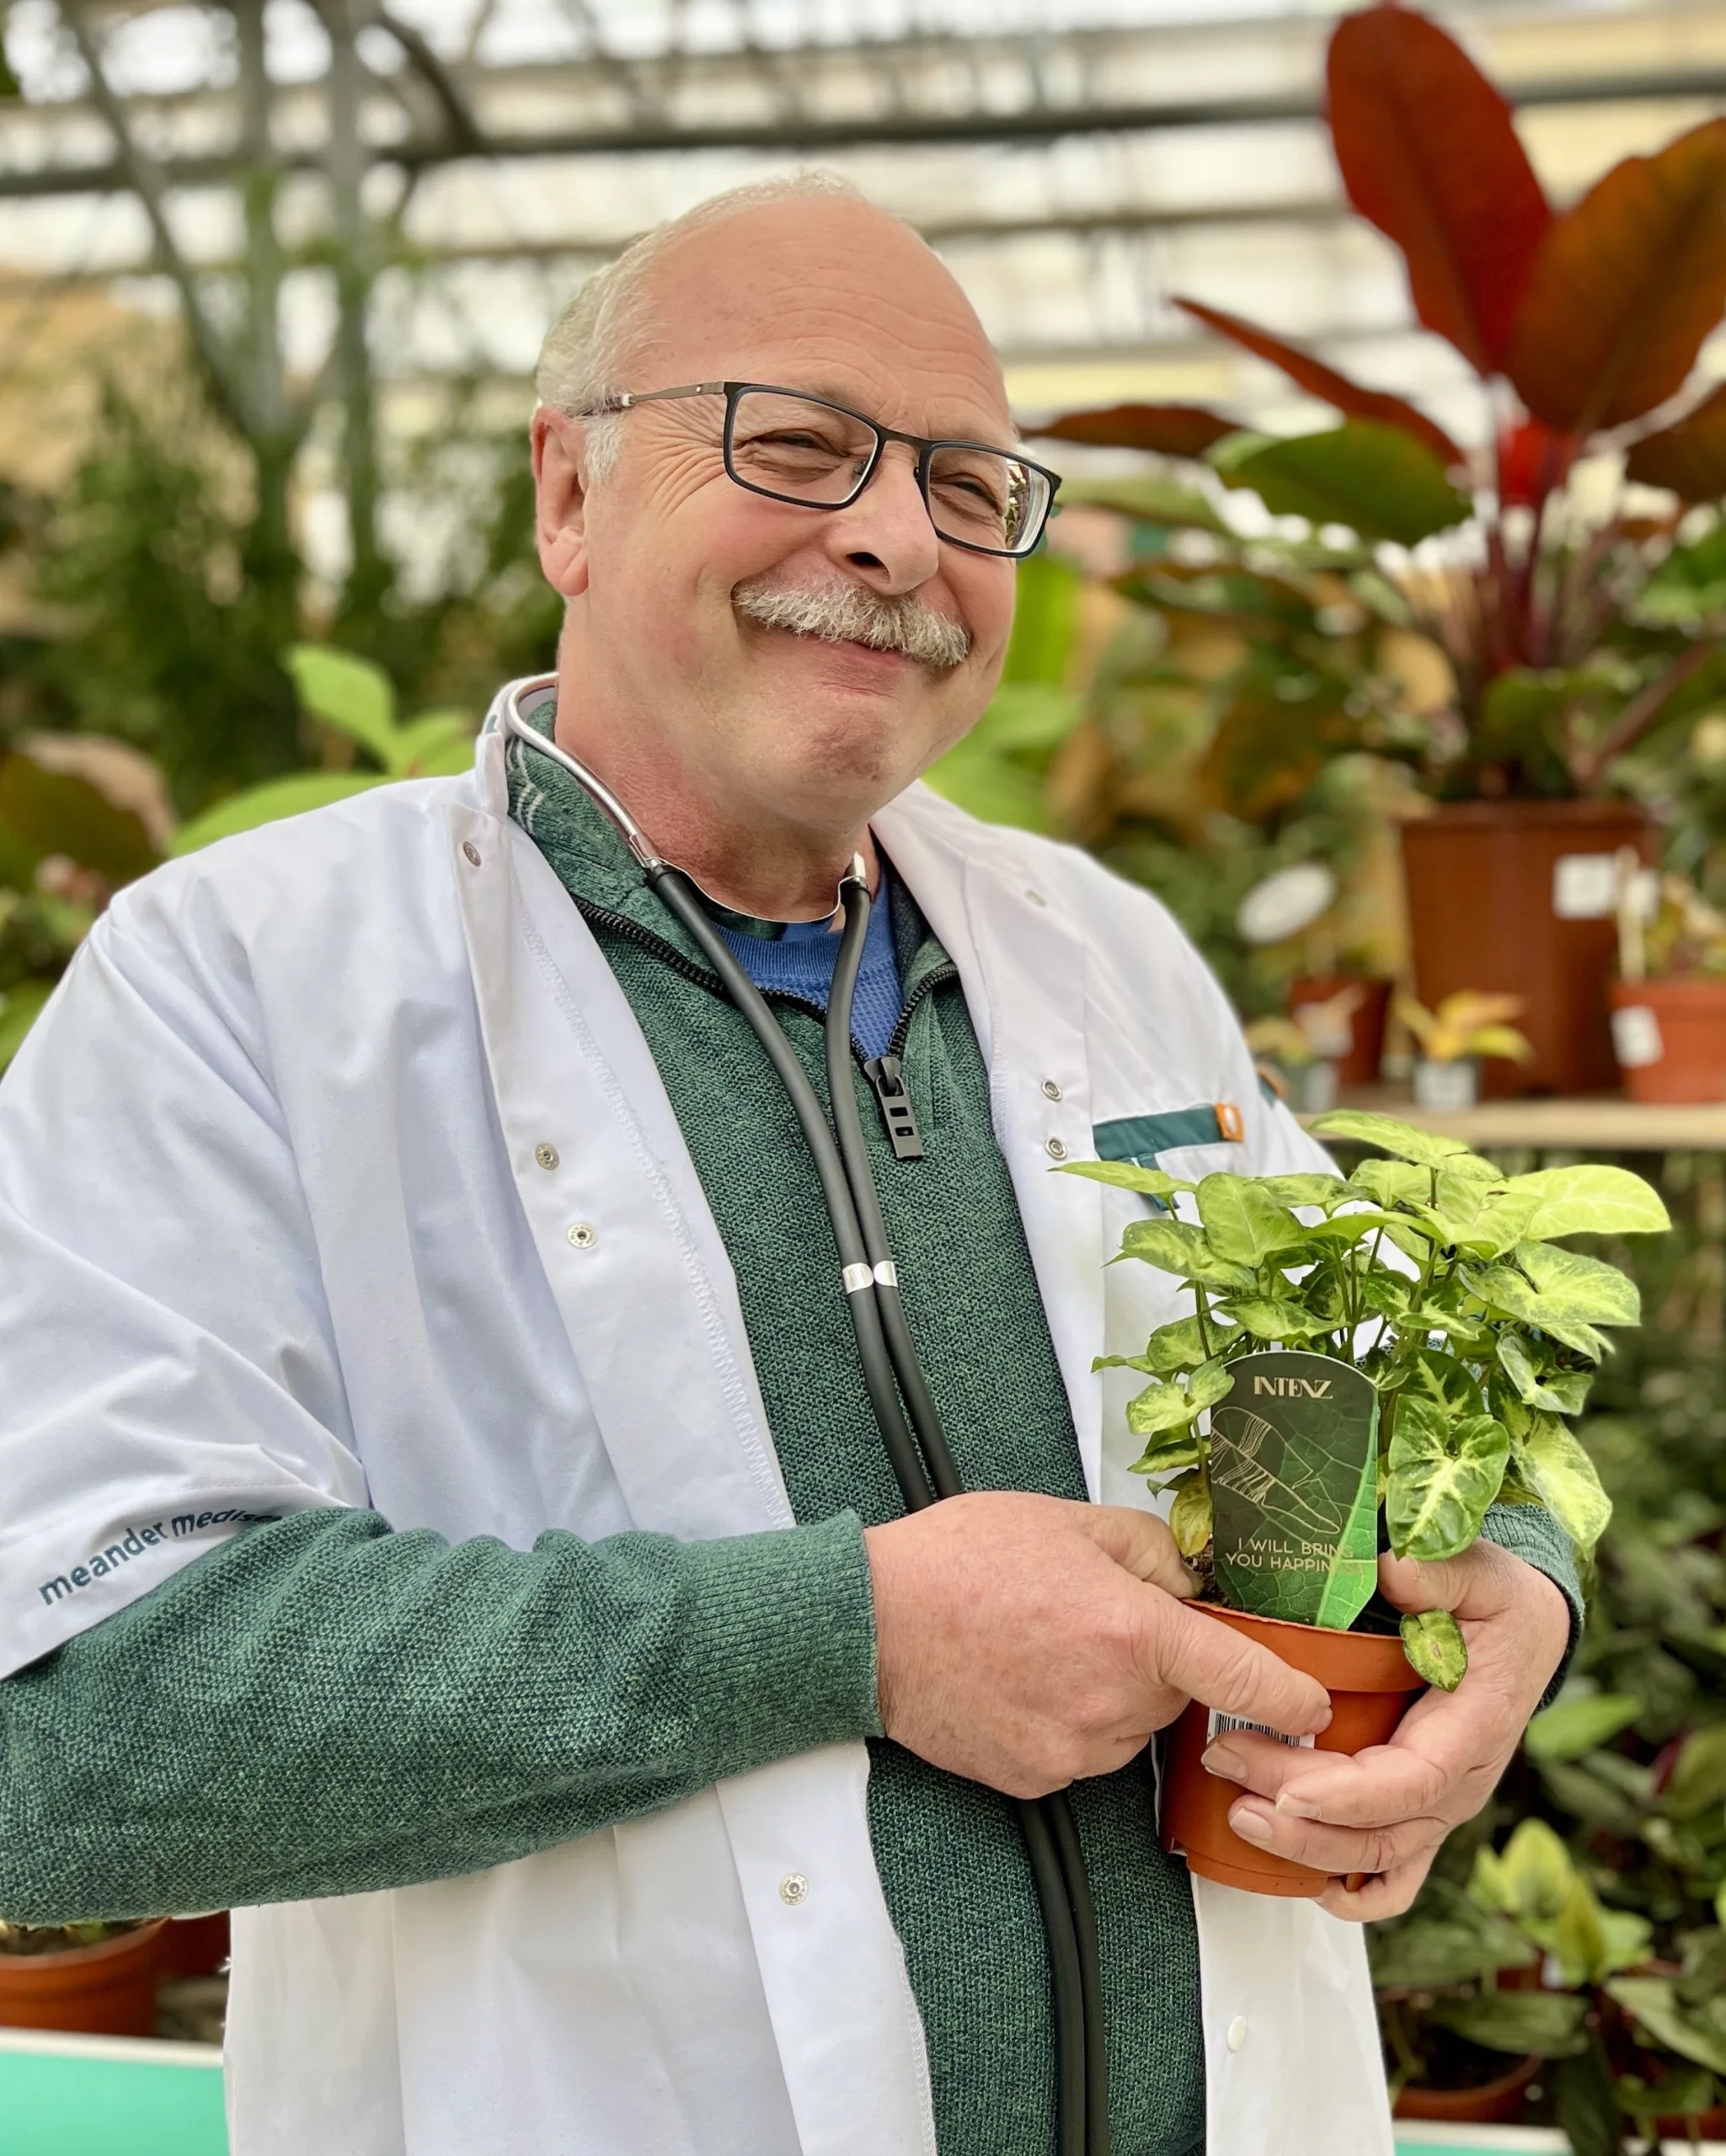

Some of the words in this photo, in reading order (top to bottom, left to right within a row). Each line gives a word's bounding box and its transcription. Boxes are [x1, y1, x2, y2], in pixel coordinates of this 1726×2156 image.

[1253, 1375, 1333, 1400] INTENZ
[1238, 1537, 1242, 1550] I
[1250, 1539, 1294, 1555] WILL
[1301, 1542, 1354, 1558] BRING
[38, 1521, 168, 1605] meander
[1225, 1552, 1263, 1568] YOU
[1270, 1557, 1363, 1574] HAPPIN
